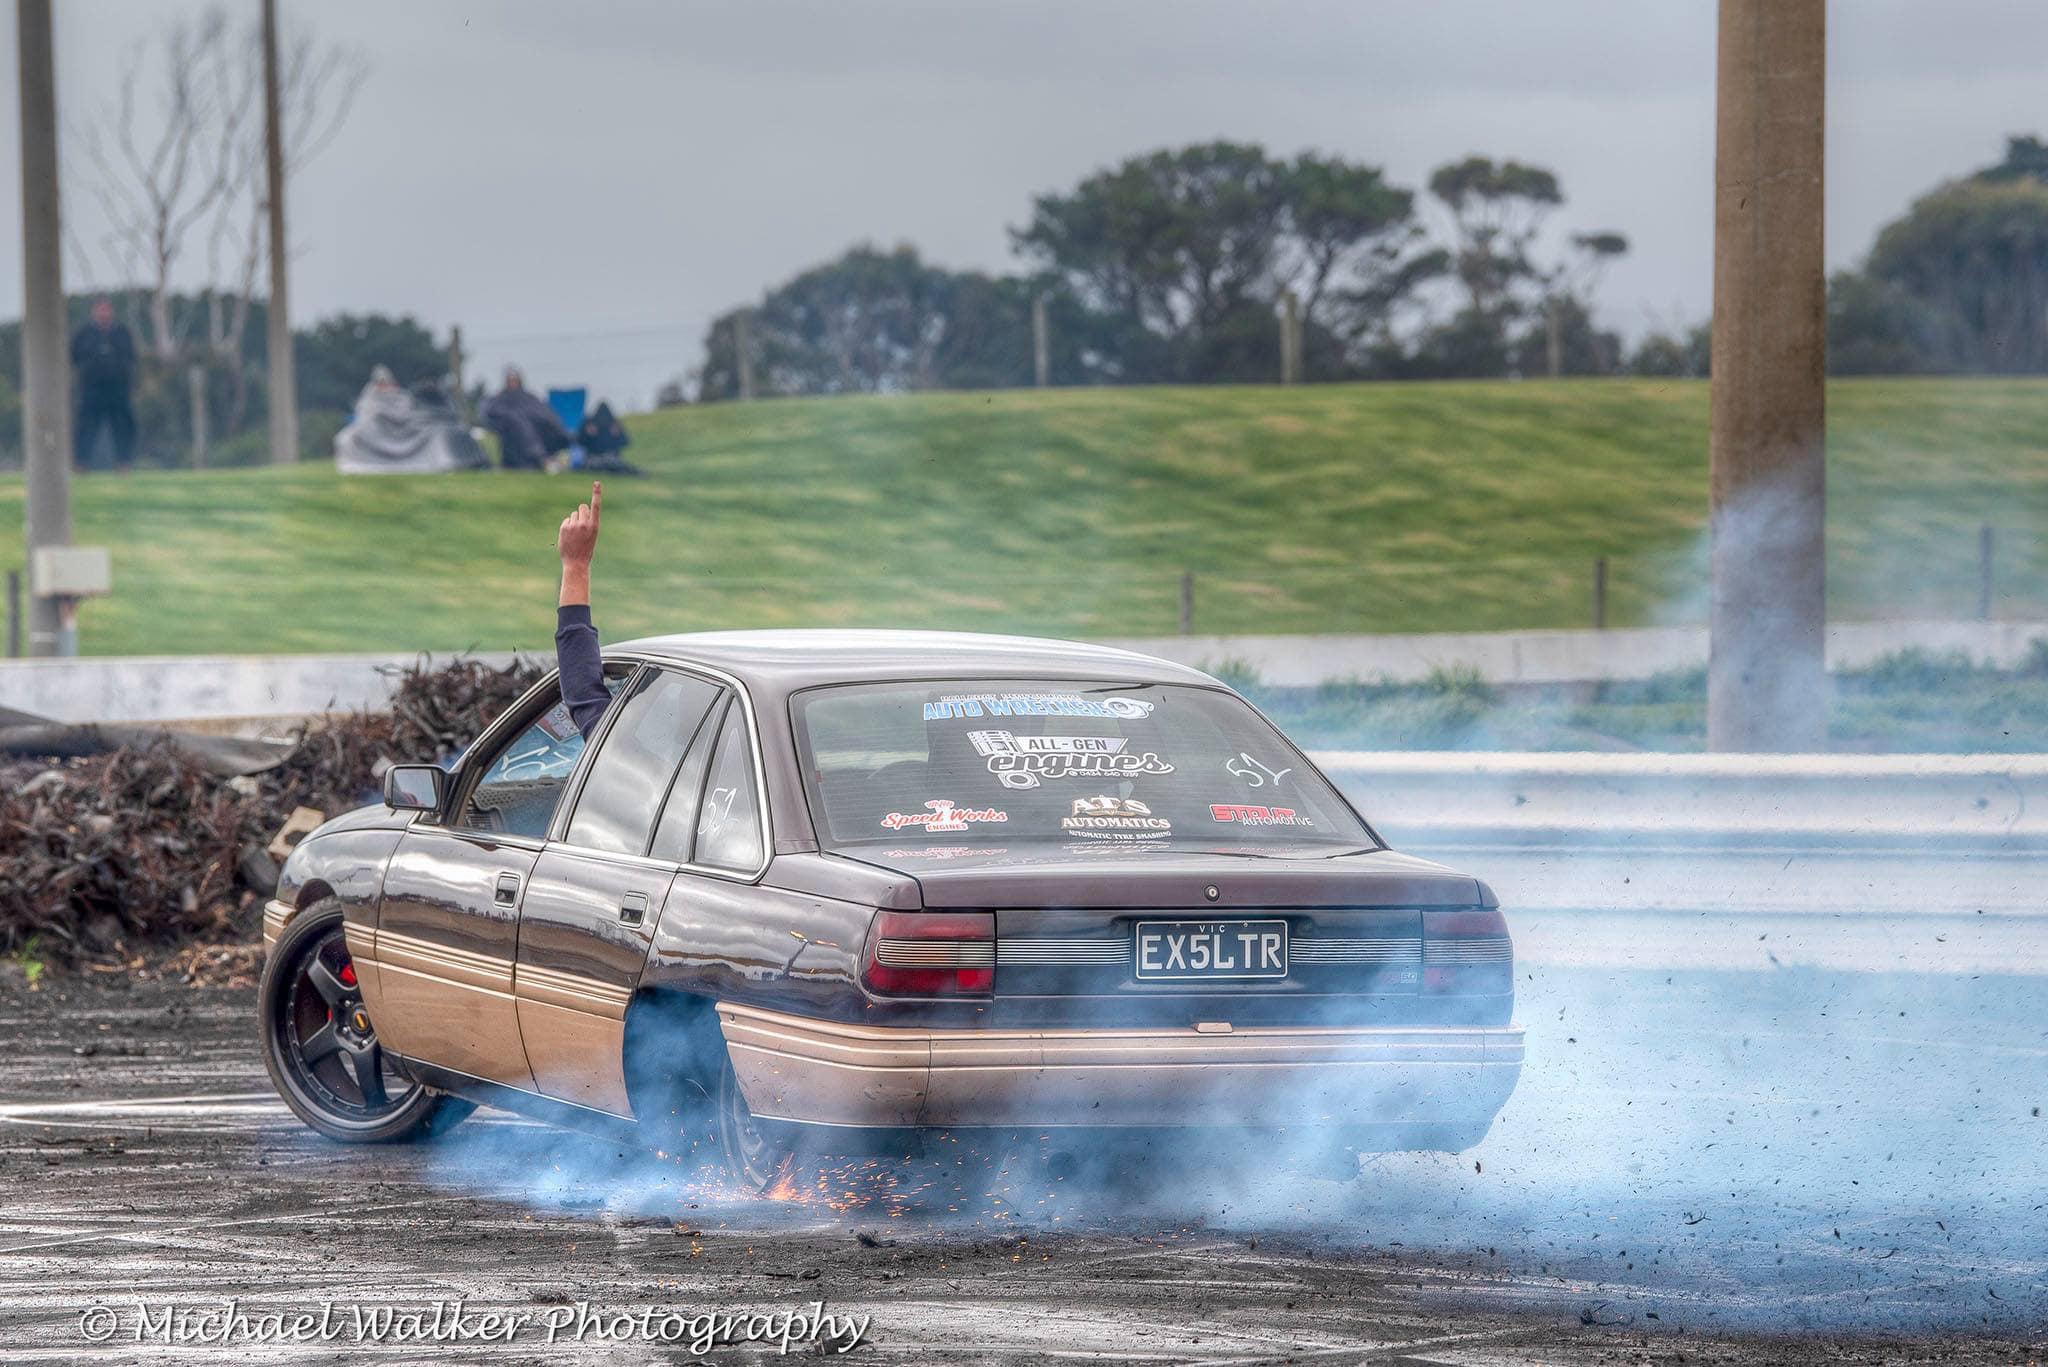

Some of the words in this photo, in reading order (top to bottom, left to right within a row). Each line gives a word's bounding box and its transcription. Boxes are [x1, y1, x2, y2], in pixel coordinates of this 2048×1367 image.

[924, 702, 984, 720] AUTO
[987, 753, 1175, 778] engines
[881, 811, 944, 830] Speed
[949, 808, 1008, 823] Works
[1061, 817, 1171, 830] AUTOMATICS
[1242, 816, 1314, 826] AUTOMOTIVE
[927, 823, 967, 831] ENGINES
[1069, 829, 1112, 839] AUTOMATIC
[1199, 925, 1225, 933] VIC
[1141, 934, 1282, 970] EX5LTR
